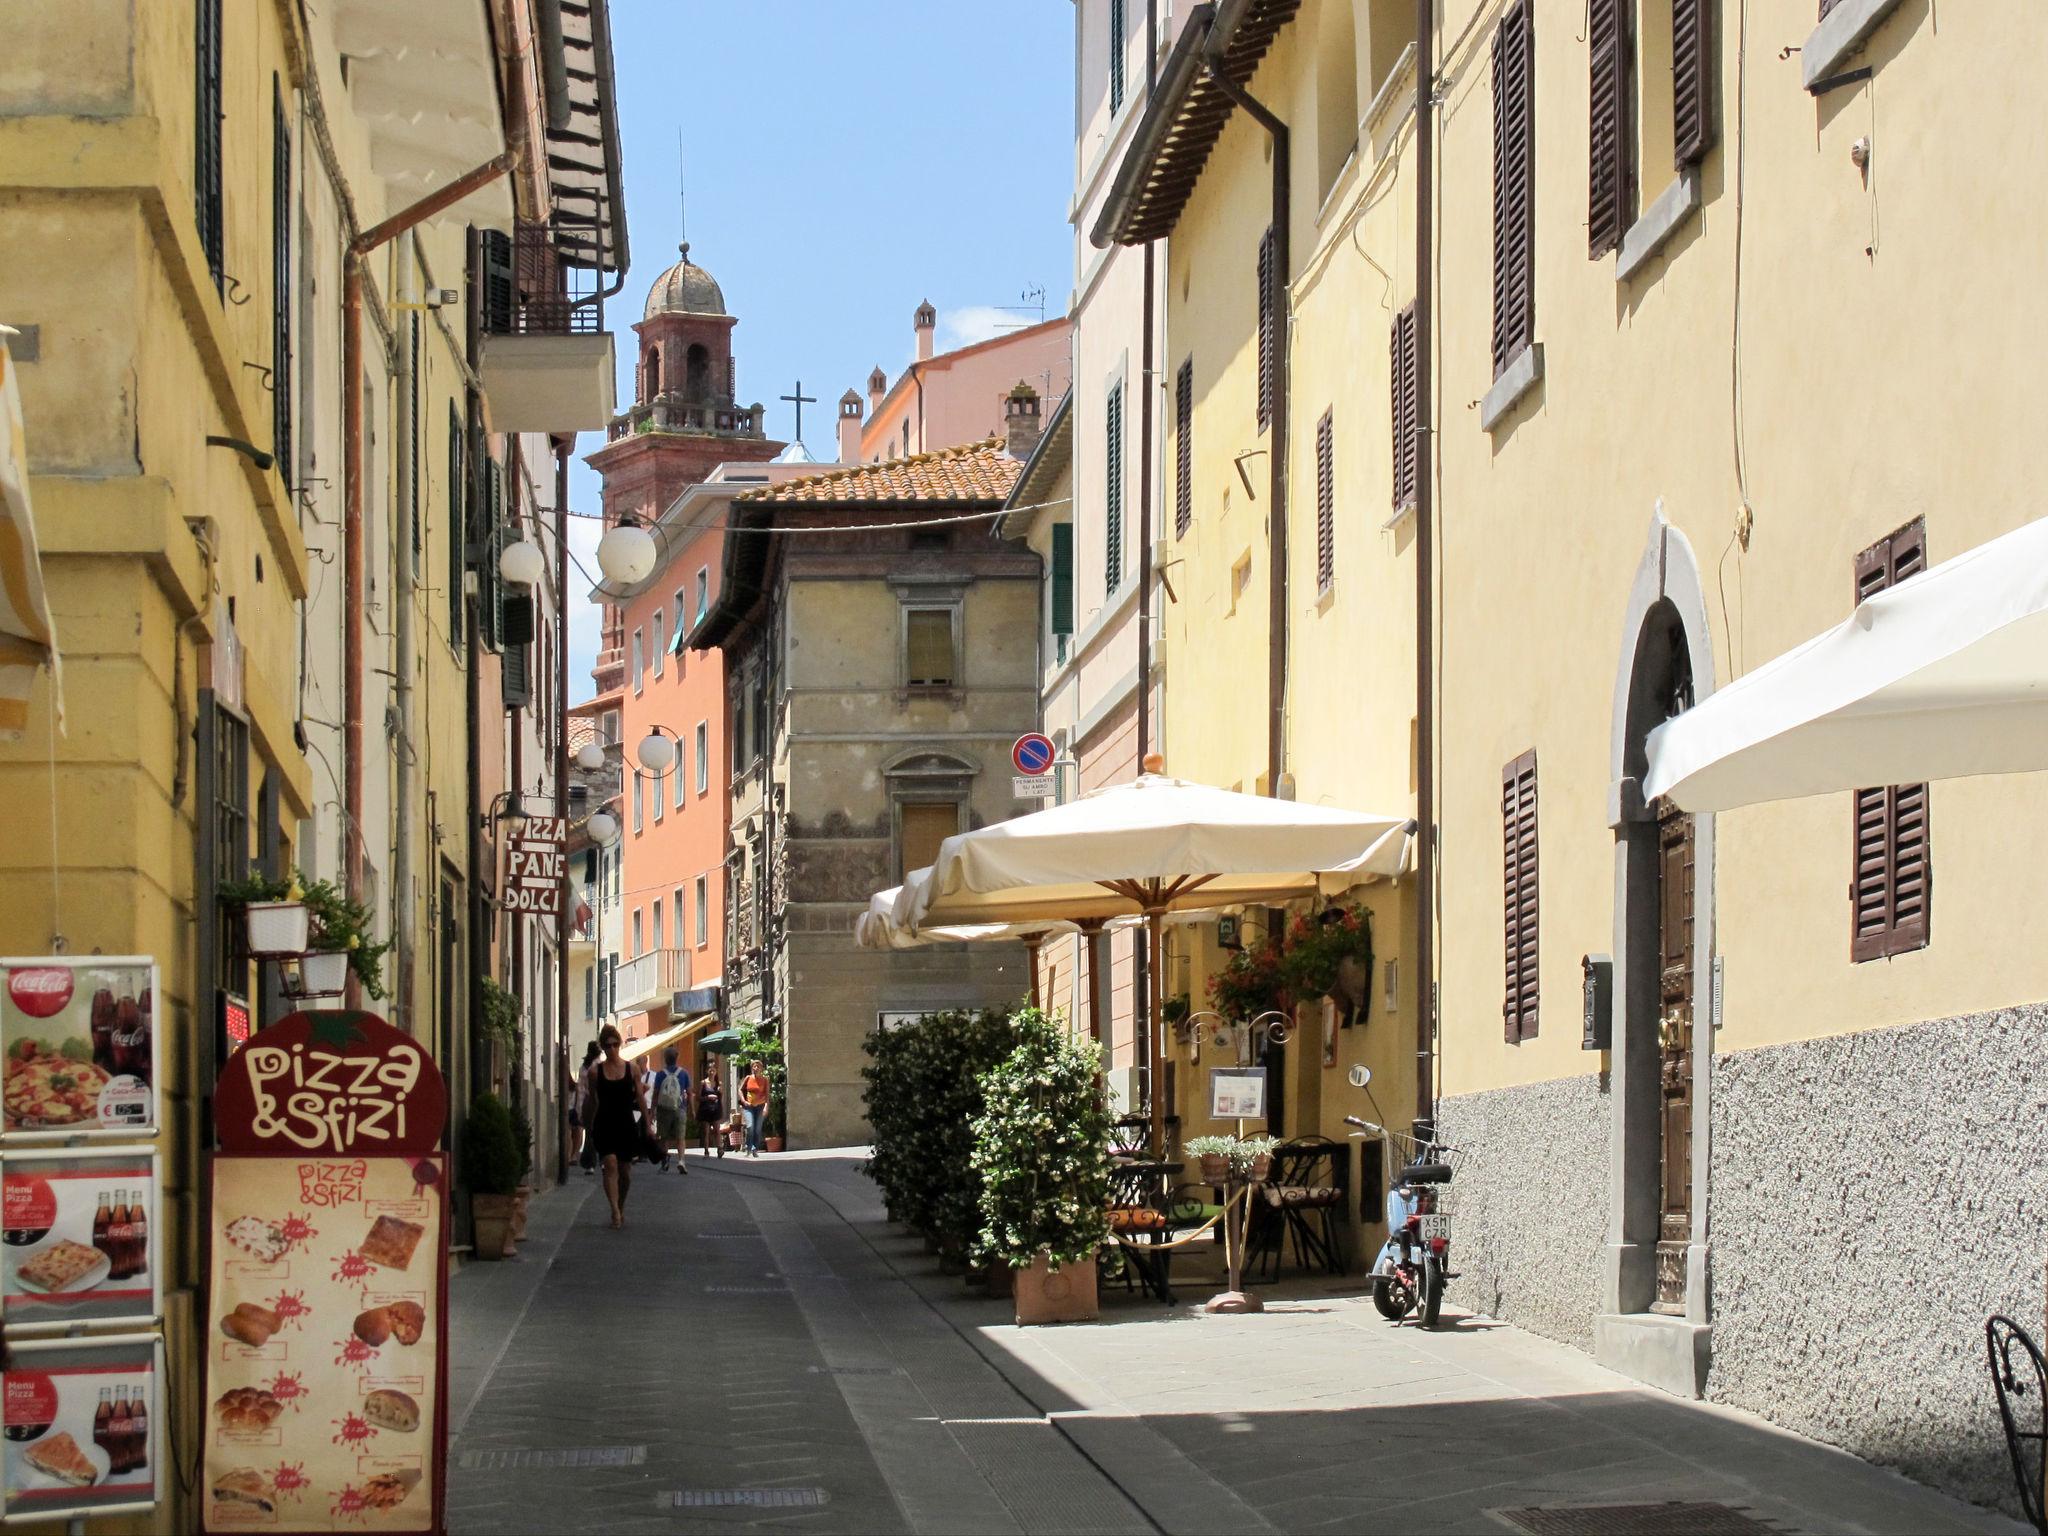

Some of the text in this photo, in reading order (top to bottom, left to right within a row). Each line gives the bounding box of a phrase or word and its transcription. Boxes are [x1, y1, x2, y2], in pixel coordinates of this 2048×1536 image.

[512, 818, 567, 841] IZZA
[510, 851, 566, 877] PANE
[505, 887, 560, 912] DOLCI
[245, 1043, 421, 1103] Pizza
[297, 1158, 368, 1187] Pizza
[6, 1186, 33, 1194] Menu
[6, 1194, 33, 1202] Pizza
[8, 1382, 35, 1390] Menu
[8, 1390, 35, 1398] Pizza
